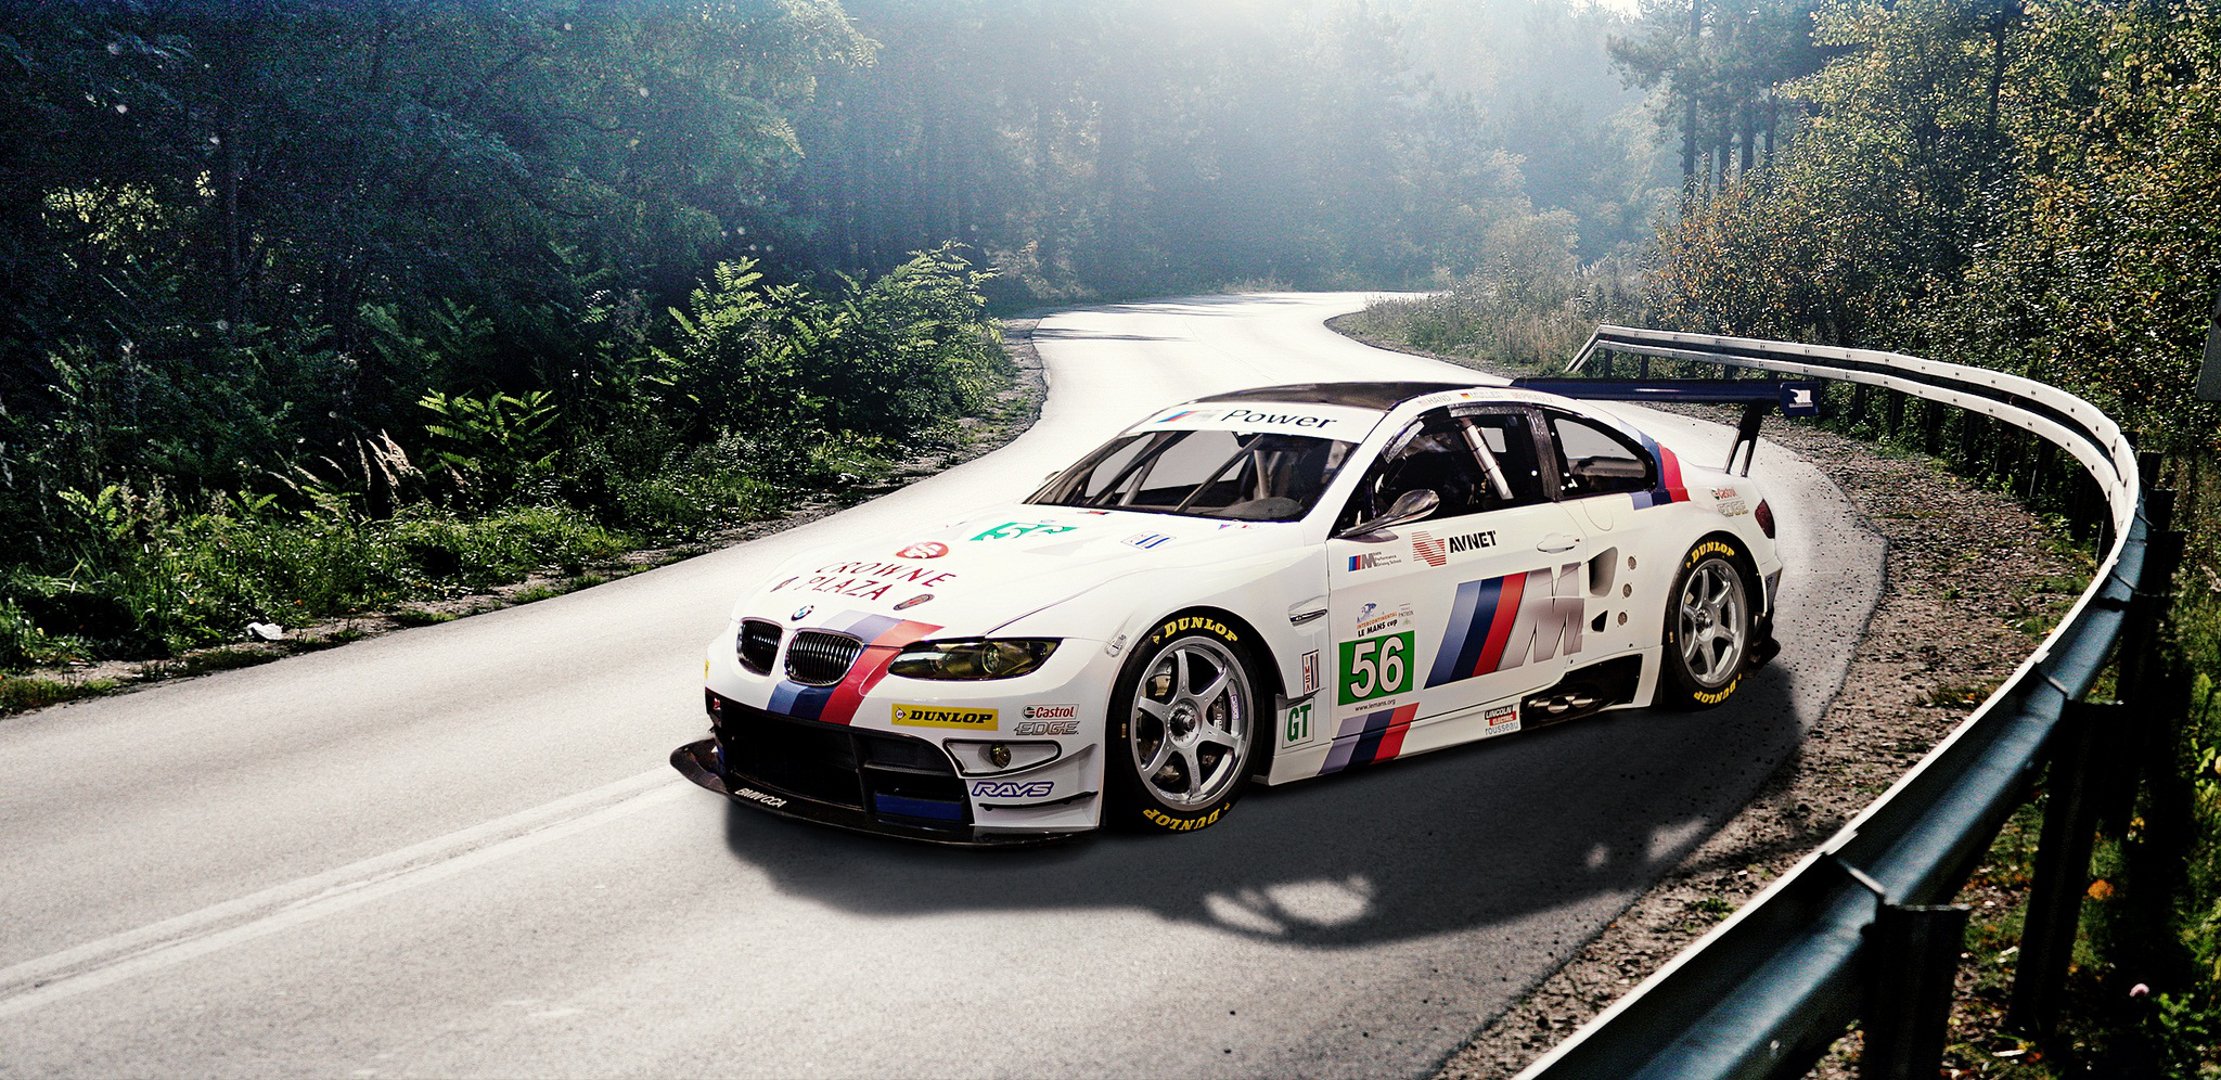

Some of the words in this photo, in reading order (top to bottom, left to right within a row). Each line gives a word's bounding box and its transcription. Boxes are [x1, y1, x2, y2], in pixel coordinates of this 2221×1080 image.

[1221, 409, 1338, 429] Power
[1448, 530, 1497, 554] AVNET
[1691, 541, 1735, 563] DUNLOP
[815, 562, 957, 587] CROWNE
[794, 576, 893, 601] PLAZA
[1164, 616, 1239, 642] DUNLOP
[1358, 629, 1365, 638] LE
[1366, 621, 1386, 635] MANS
[1349, 635, 1405, 699] 56
[1693, 679, 1737, 704] DUNLOP
[1035, 704, 1075, 719] Castrol
[1355, 699, 1396, 712] www.lemans.org
[1485, 705, 1513, 719] LINCOLN
[908, 709, 994, 724] DUNLOP
[1287, 703, 1312, 742] GT
[1013, 720, 1080, 736] EDGE
[735, 787, 765, 801] BMW
[971, 781, 1054, 798] RAYS
[1142, 808, 1221, 831] DUNLOP
